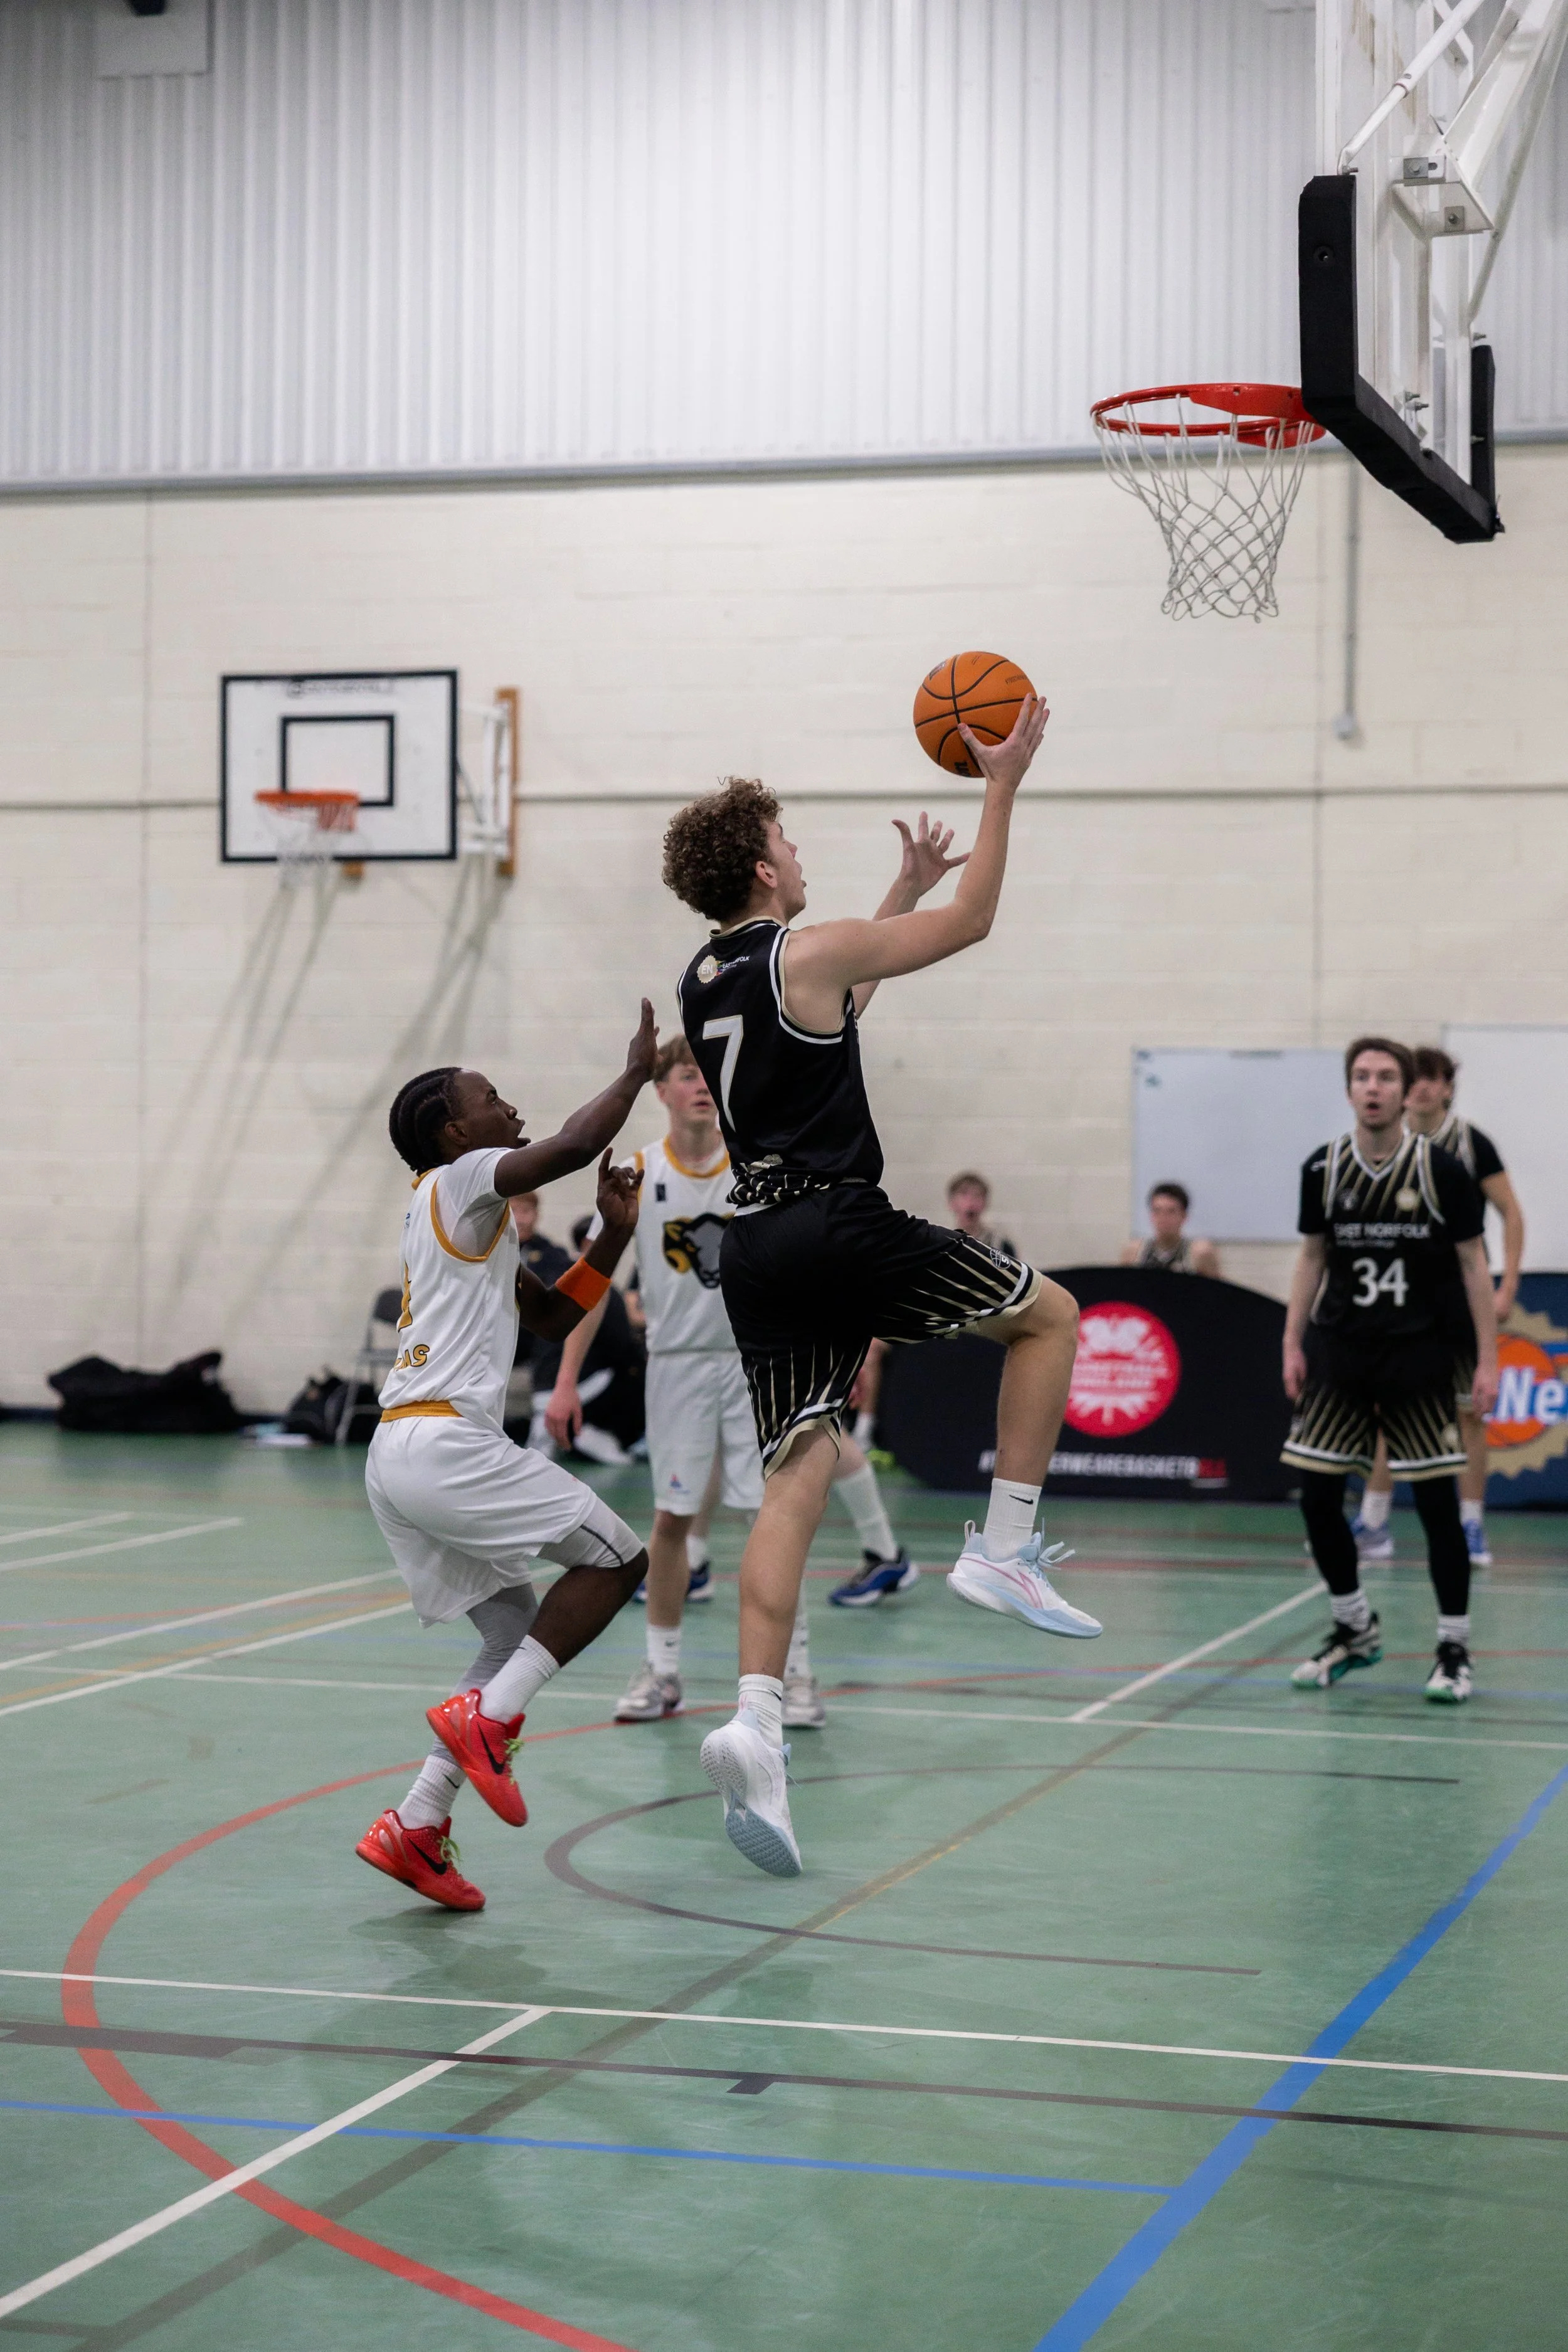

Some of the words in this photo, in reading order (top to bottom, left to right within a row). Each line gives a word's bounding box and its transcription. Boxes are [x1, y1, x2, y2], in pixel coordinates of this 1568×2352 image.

[701, 965, 713, 975] EN
[702, 1014, 743, 1132] 7
[1363, 1223, 1431, 1239] NORFOLK
[1352, 1256, 1409, 1308] 34
